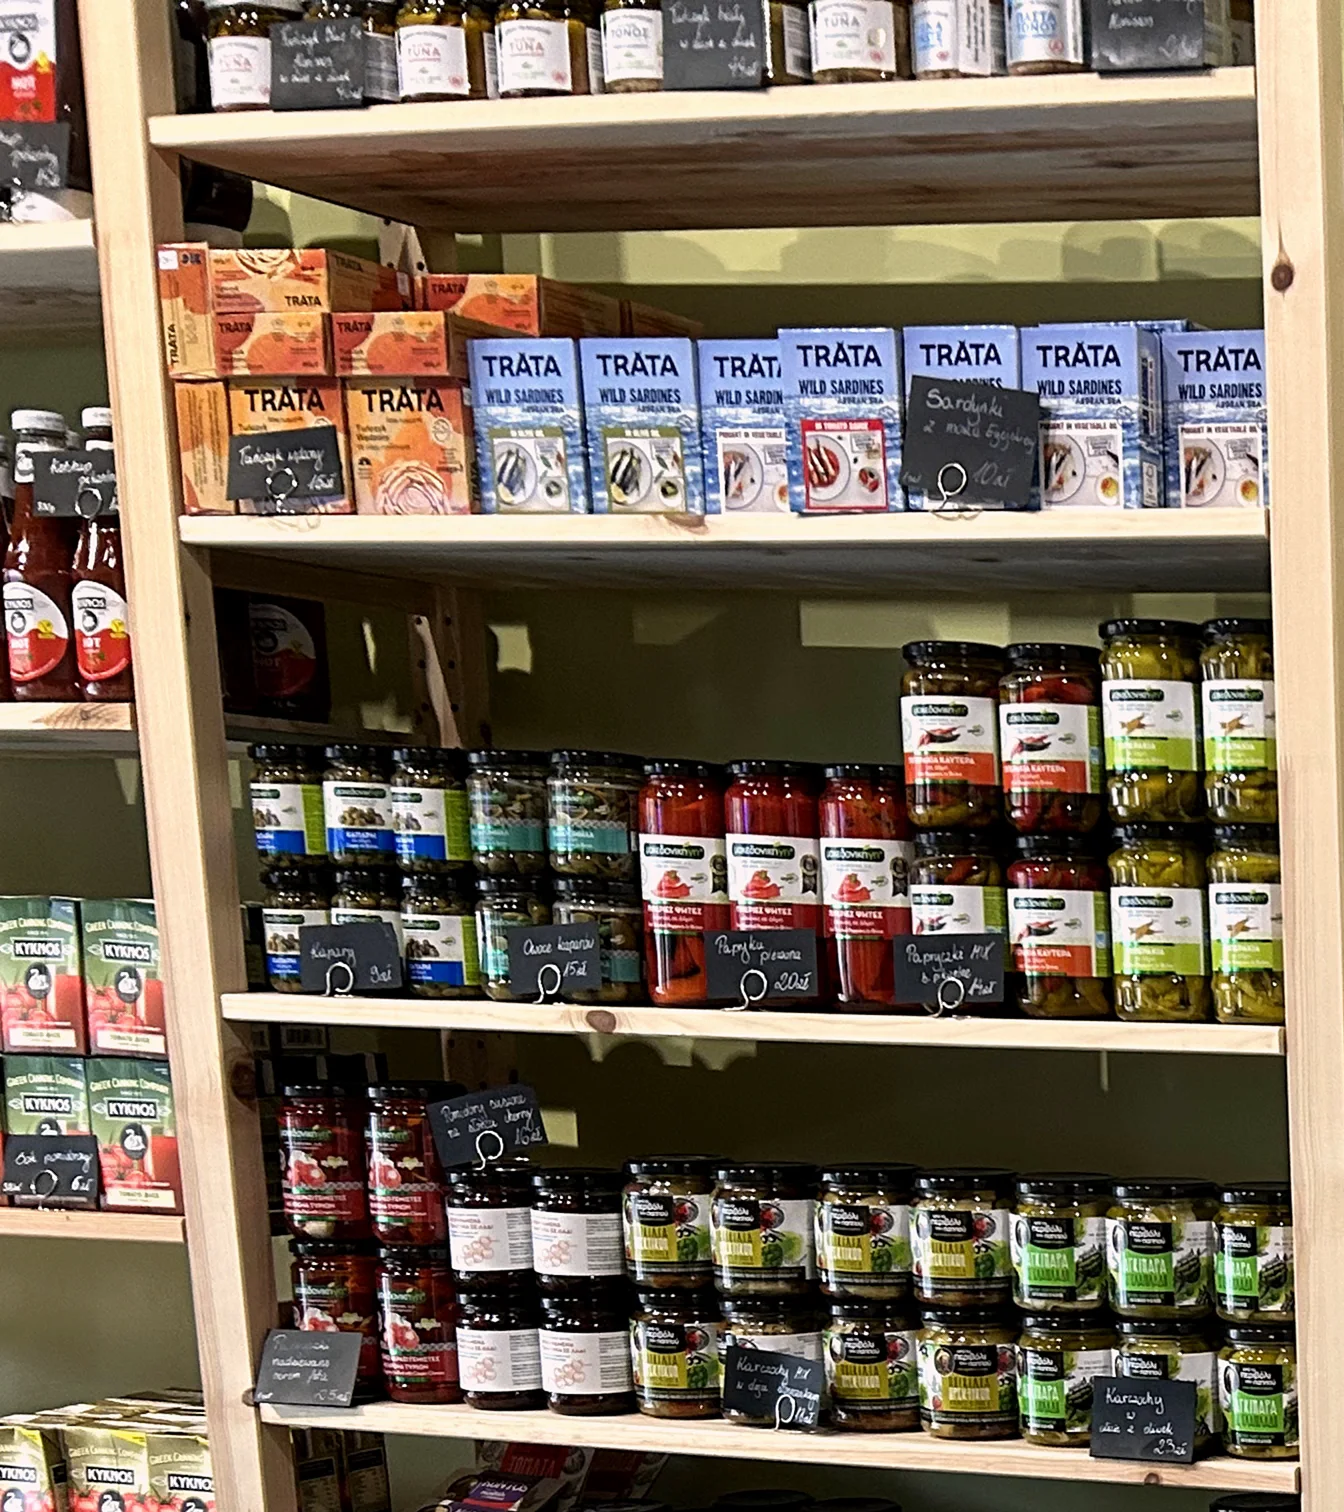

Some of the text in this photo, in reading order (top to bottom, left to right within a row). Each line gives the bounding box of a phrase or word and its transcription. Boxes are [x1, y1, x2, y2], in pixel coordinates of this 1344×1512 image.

[799, 379, 884, 395] WILD SARDINES
[1037, 379, 1122, 396] WILD SARDINES
[1178, 383, 1262, 399] WILD SARDINES
[485, 388, 564, 404] WILD SARDINES
[599, 388, 681, 404] WILD SARDINES
[715, 389, 742, 405] WILD
[14, 940, 61, 957] KYKNOS
[104, 943, 150, 960] KYKNOS
[25, 1094, 71, 1111] KYKNOS
[109, 1101, 155, 1118] KYKNOS
[87, 1467, 135, 1484] KYKNOS
